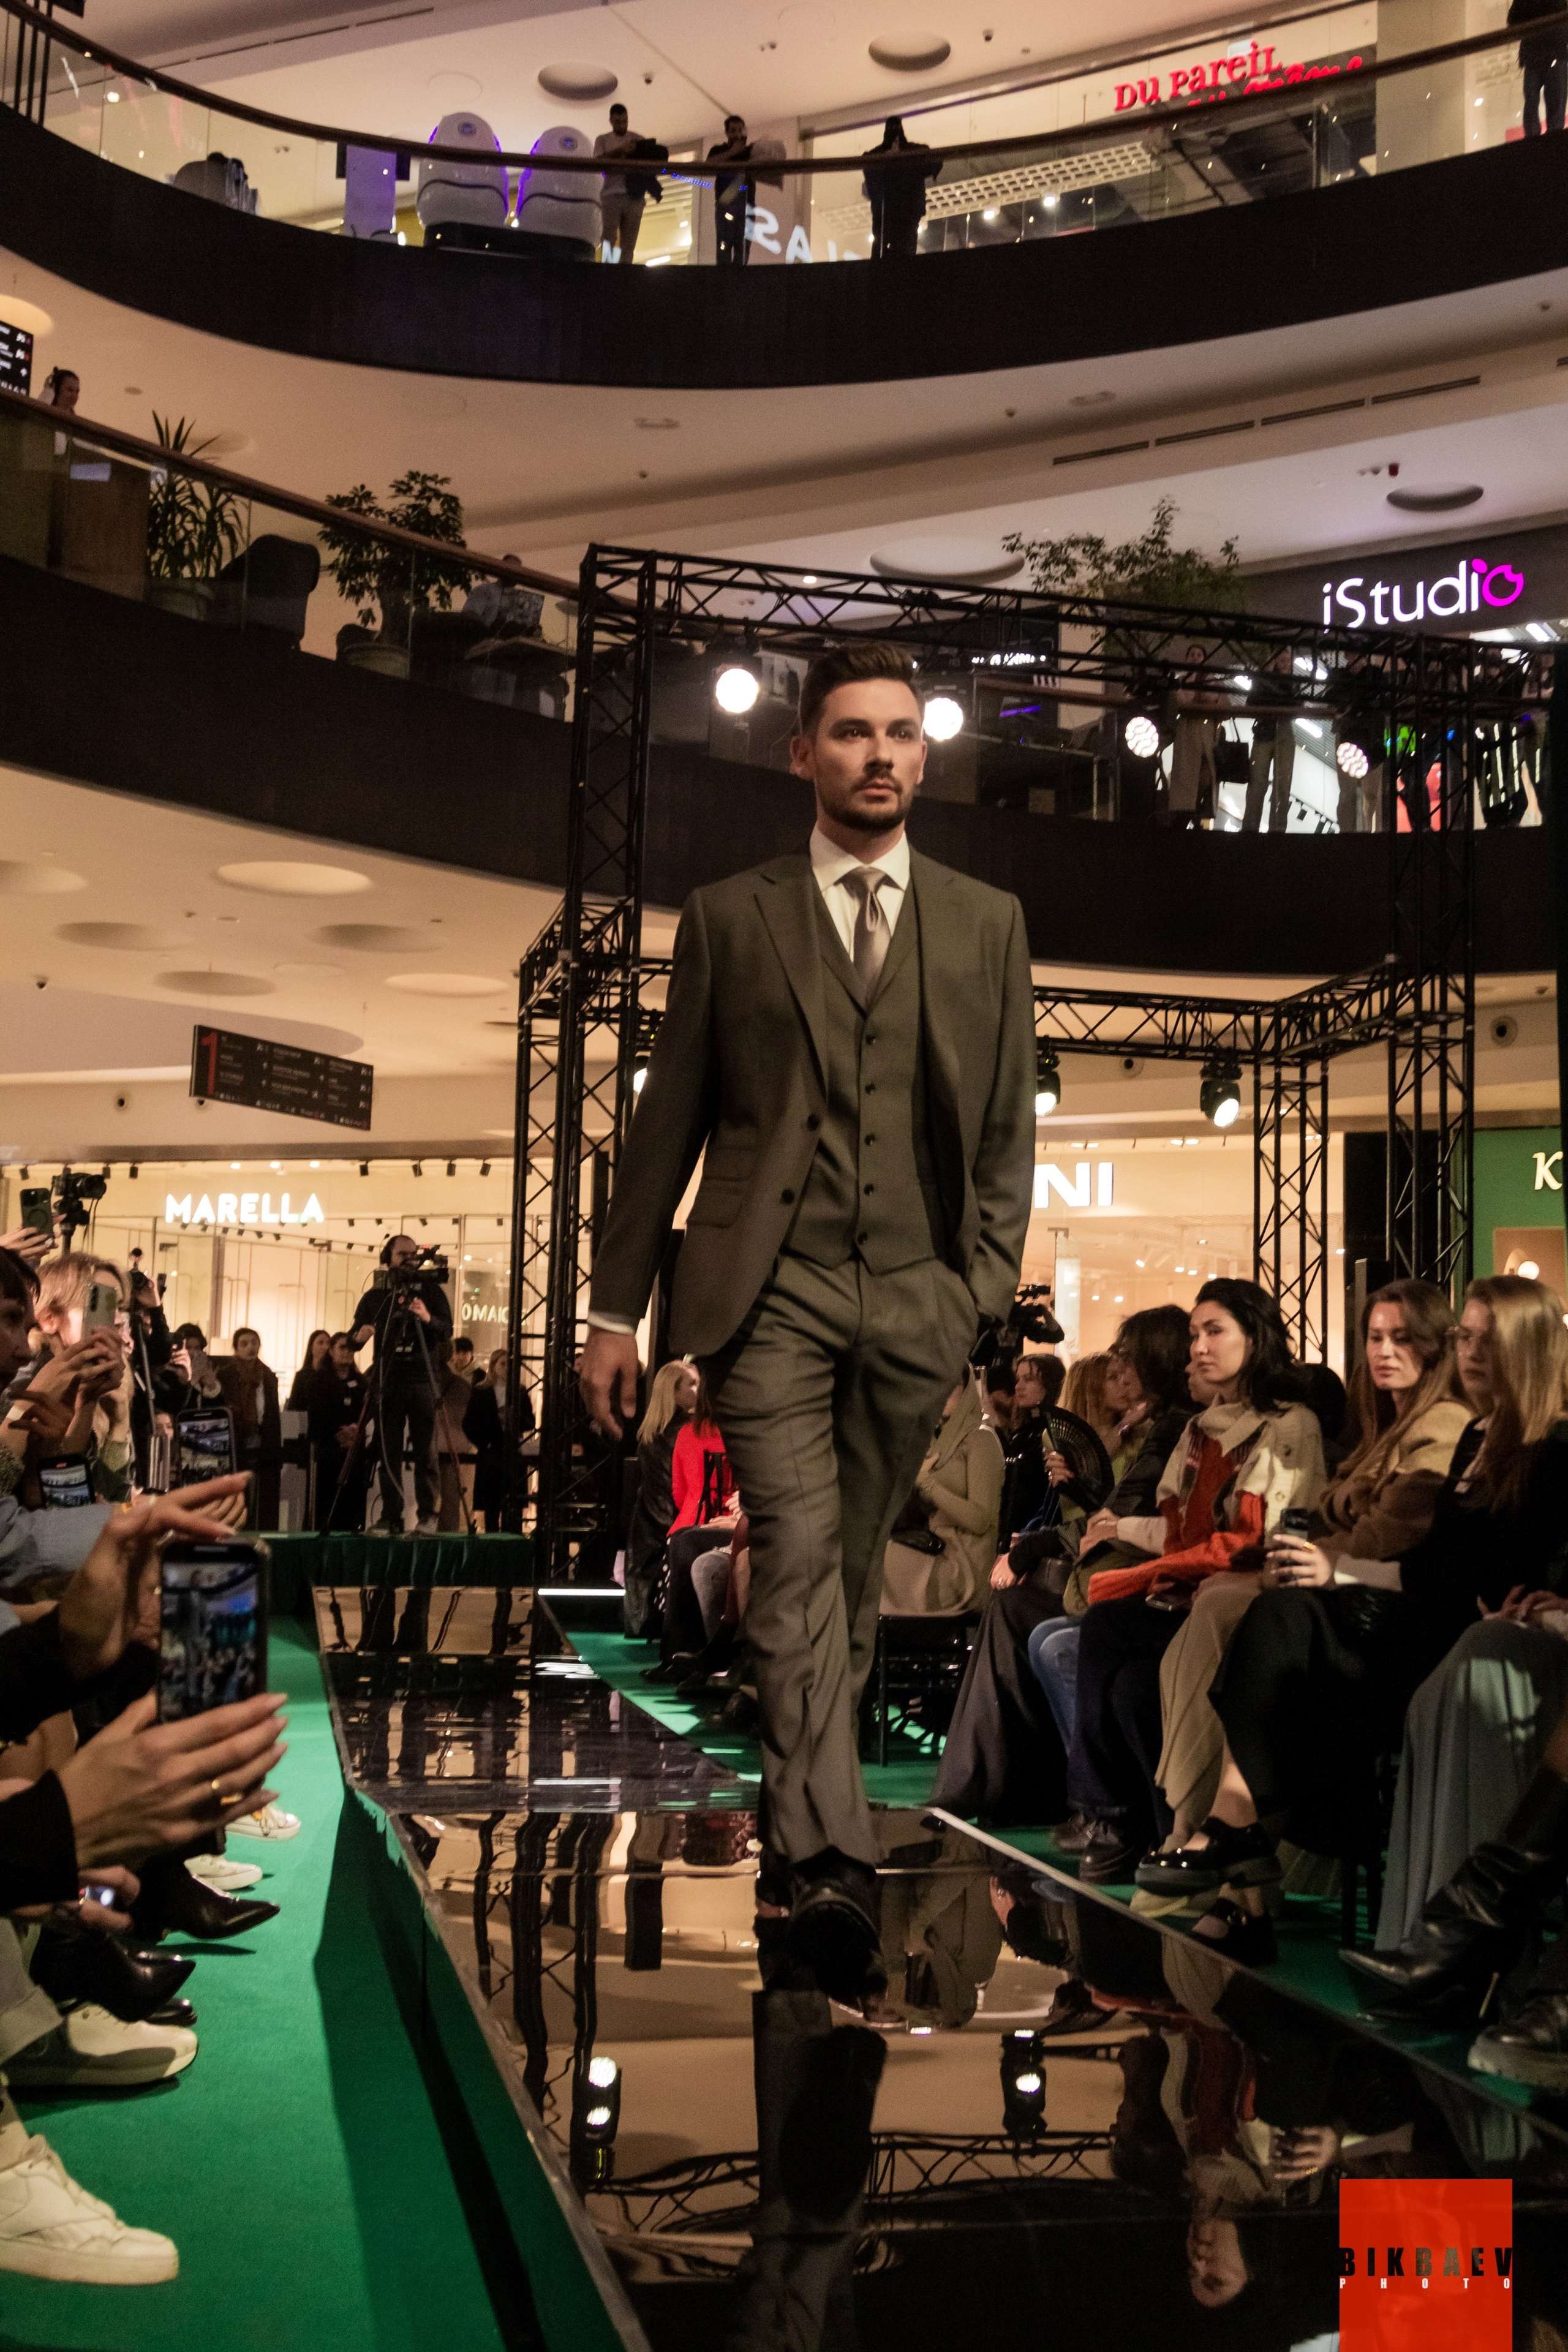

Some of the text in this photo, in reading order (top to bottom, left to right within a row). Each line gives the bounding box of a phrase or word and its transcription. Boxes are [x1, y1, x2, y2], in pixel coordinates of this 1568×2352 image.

[1114, 75, 1161, 111] DU
[1322, 558, 1525, 633] iStudio
[201, 1031, 218, 1096] 1
[165, 1193, 325, 1224] MARELLA
